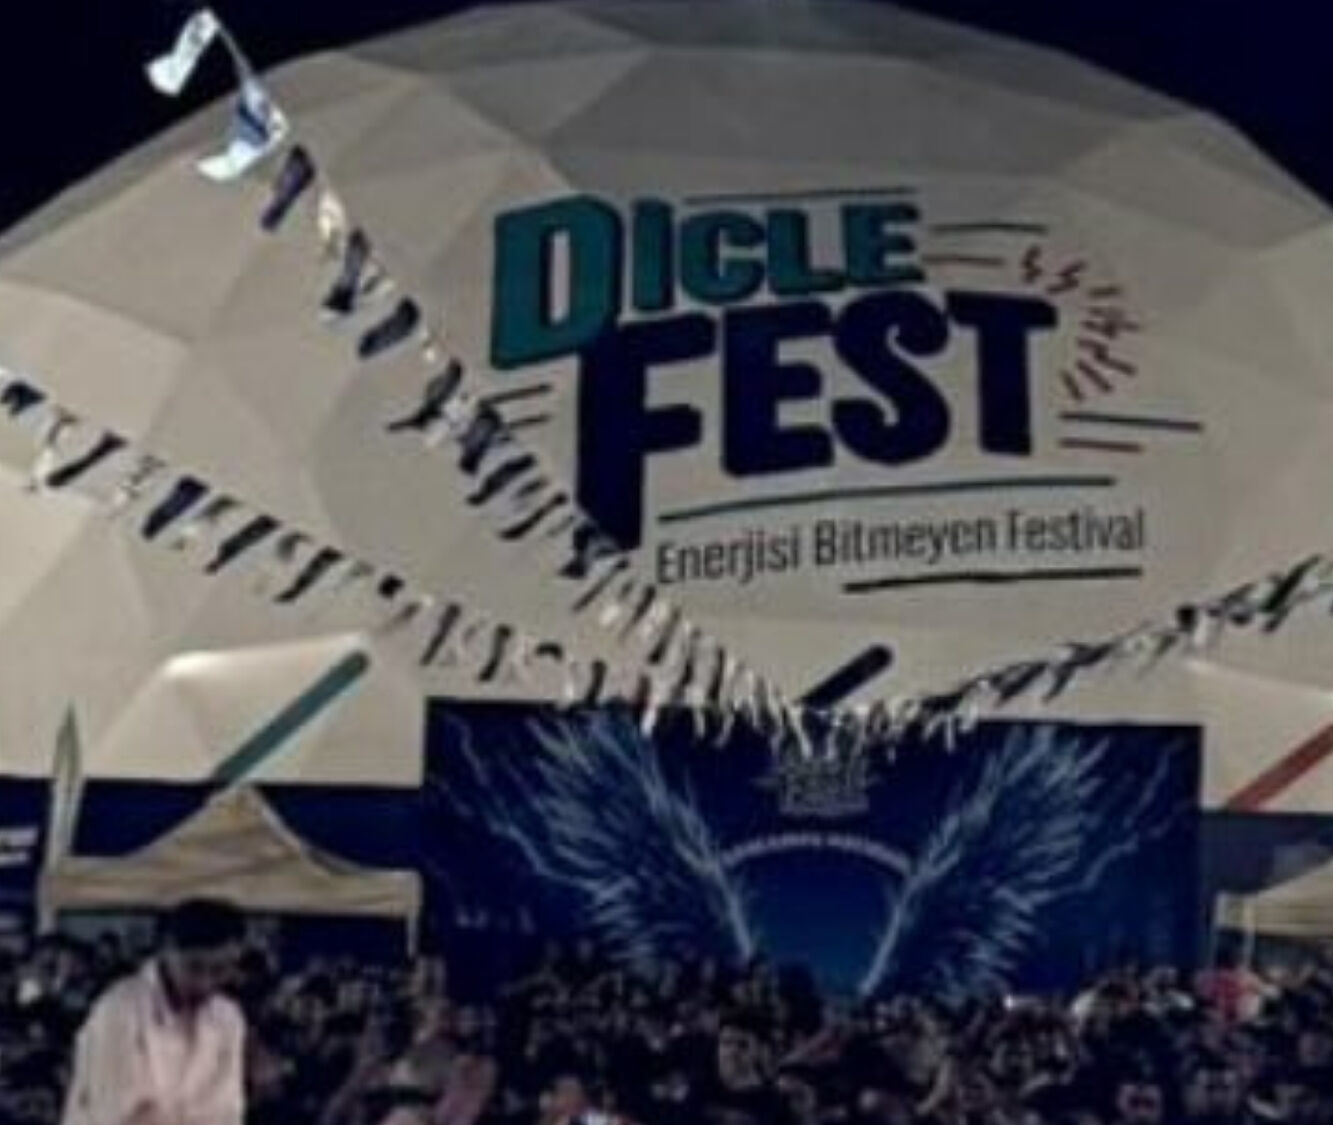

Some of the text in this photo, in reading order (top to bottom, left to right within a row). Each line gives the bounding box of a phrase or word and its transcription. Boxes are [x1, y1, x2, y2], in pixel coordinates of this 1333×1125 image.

[489, 194, 928, 370] DICLE
[573, 288, 1060, 554] FEST
[655, 506, 1145, 584] Enerjisi Bitmeyen Festival
